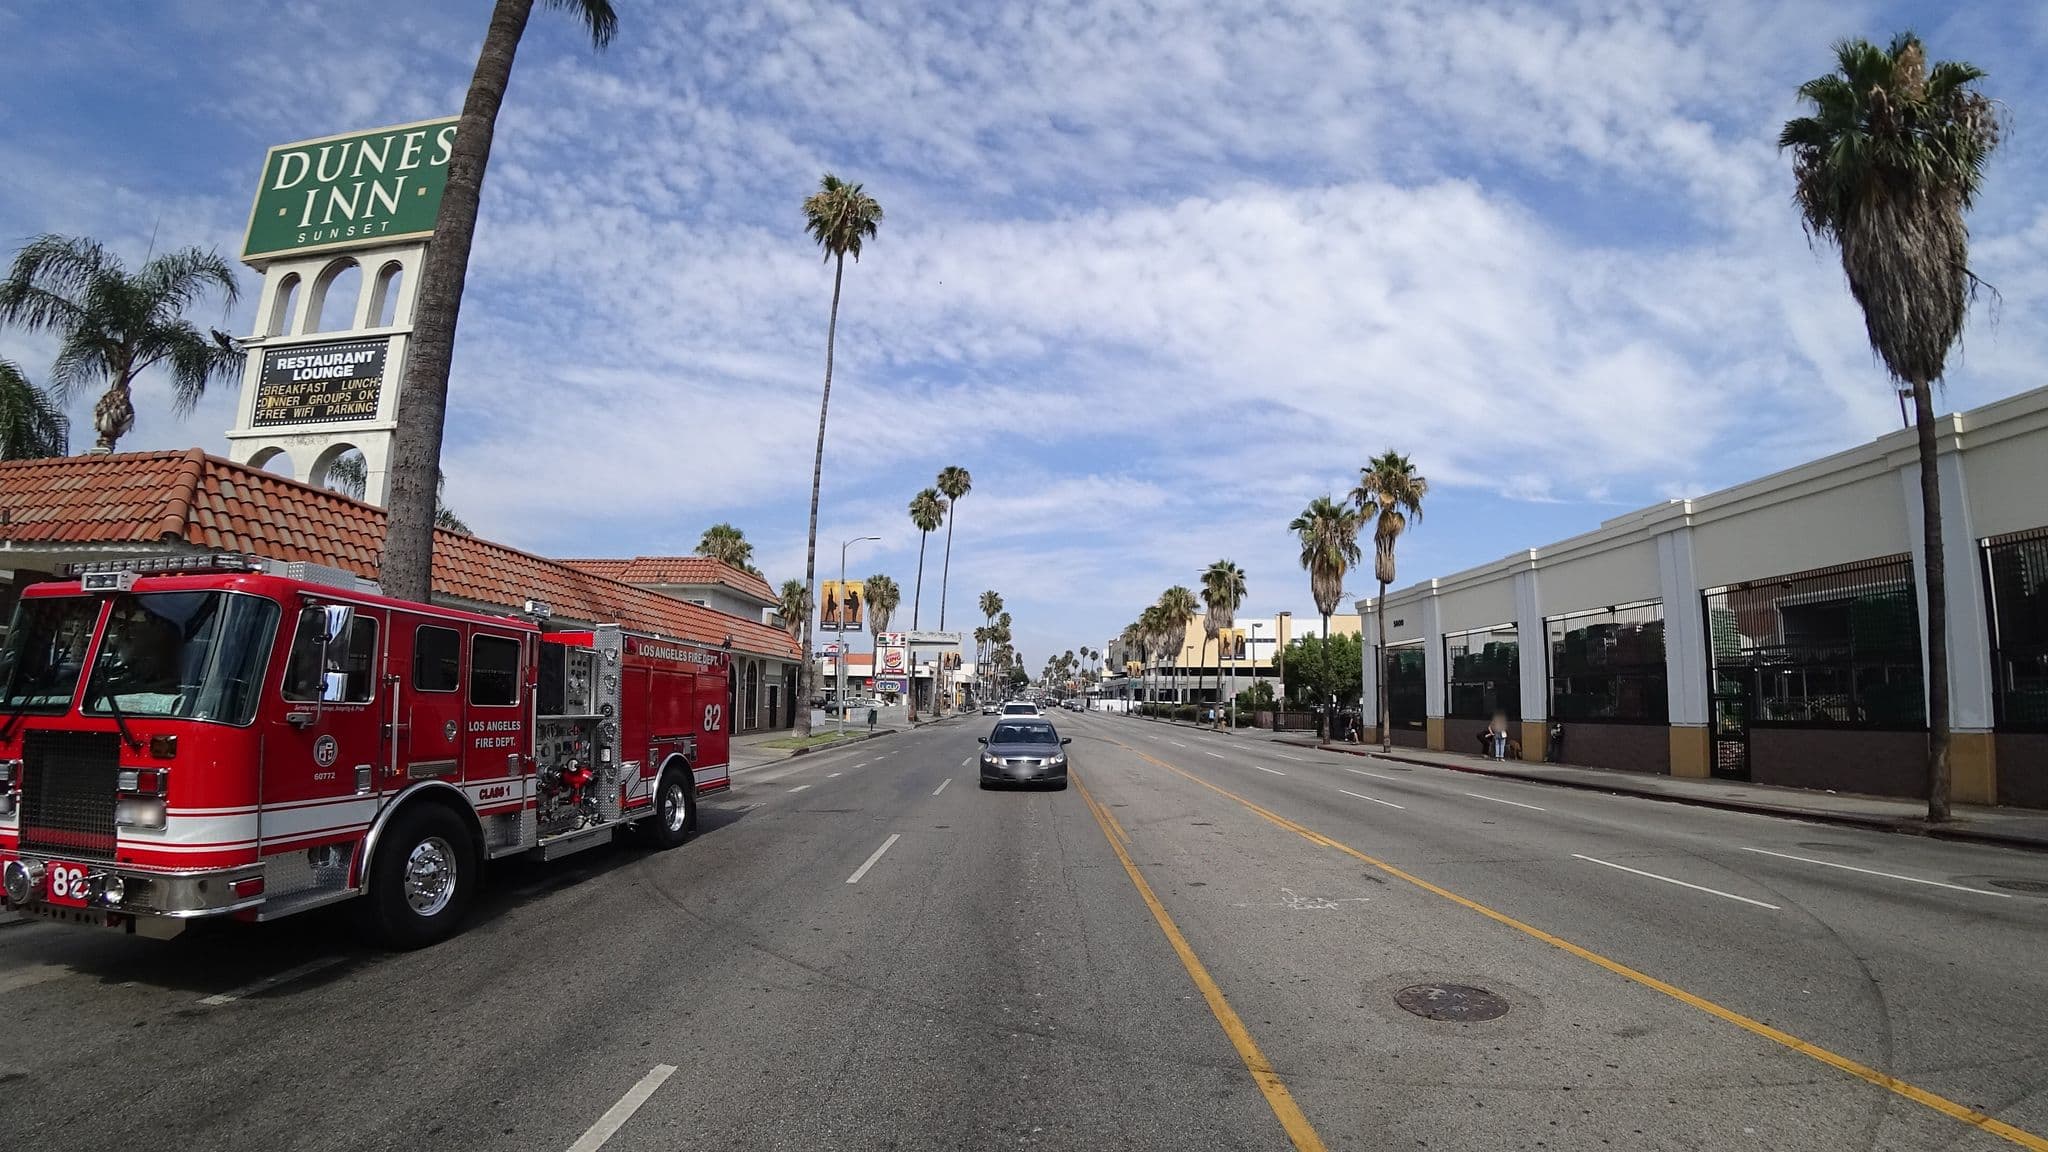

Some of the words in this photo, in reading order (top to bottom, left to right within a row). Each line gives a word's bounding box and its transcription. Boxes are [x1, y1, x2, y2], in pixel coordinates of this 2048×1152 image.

[272, 126, 458, 191] DUNES
[296, 175, 408, 228] INN
[297, 221, 390, 243] SUNSET
[277, 350, 376, 371] RESTAURANT
[293, 365, 355, 381] LOUNGE
[263, 381, 328, 396] BREAKFAST
[341, 377, 377, 391] LUNCH
[261, 395, 300, 408] DINNER
[308, 391, 352, 405] GROUPS
[358, 389, 375, 400] OK
[258, 408, 286, 420] FREE
[293, 406, 315, 418] WIFI
[326, 402, 374, 416] PARKING
[639, 643, 655, 656] LOS
[655, 646, 688, 662] ANGELES
[688, 652, 703, 664] FIRE
[703, 654, 718, 666] DEPT.
[468, 721, 485, 732] LOS
[486, 720, 521, 732] ANGELES
[704, 704, 721, 731] 82
[475, 737, 494, 748] FIRE
[495, 736, 516, 748] DEPT.
[314, 772, 335, 781] 60772
[479, 786, 505, 800] CLASS
[53, 866, 84, 898] 82
